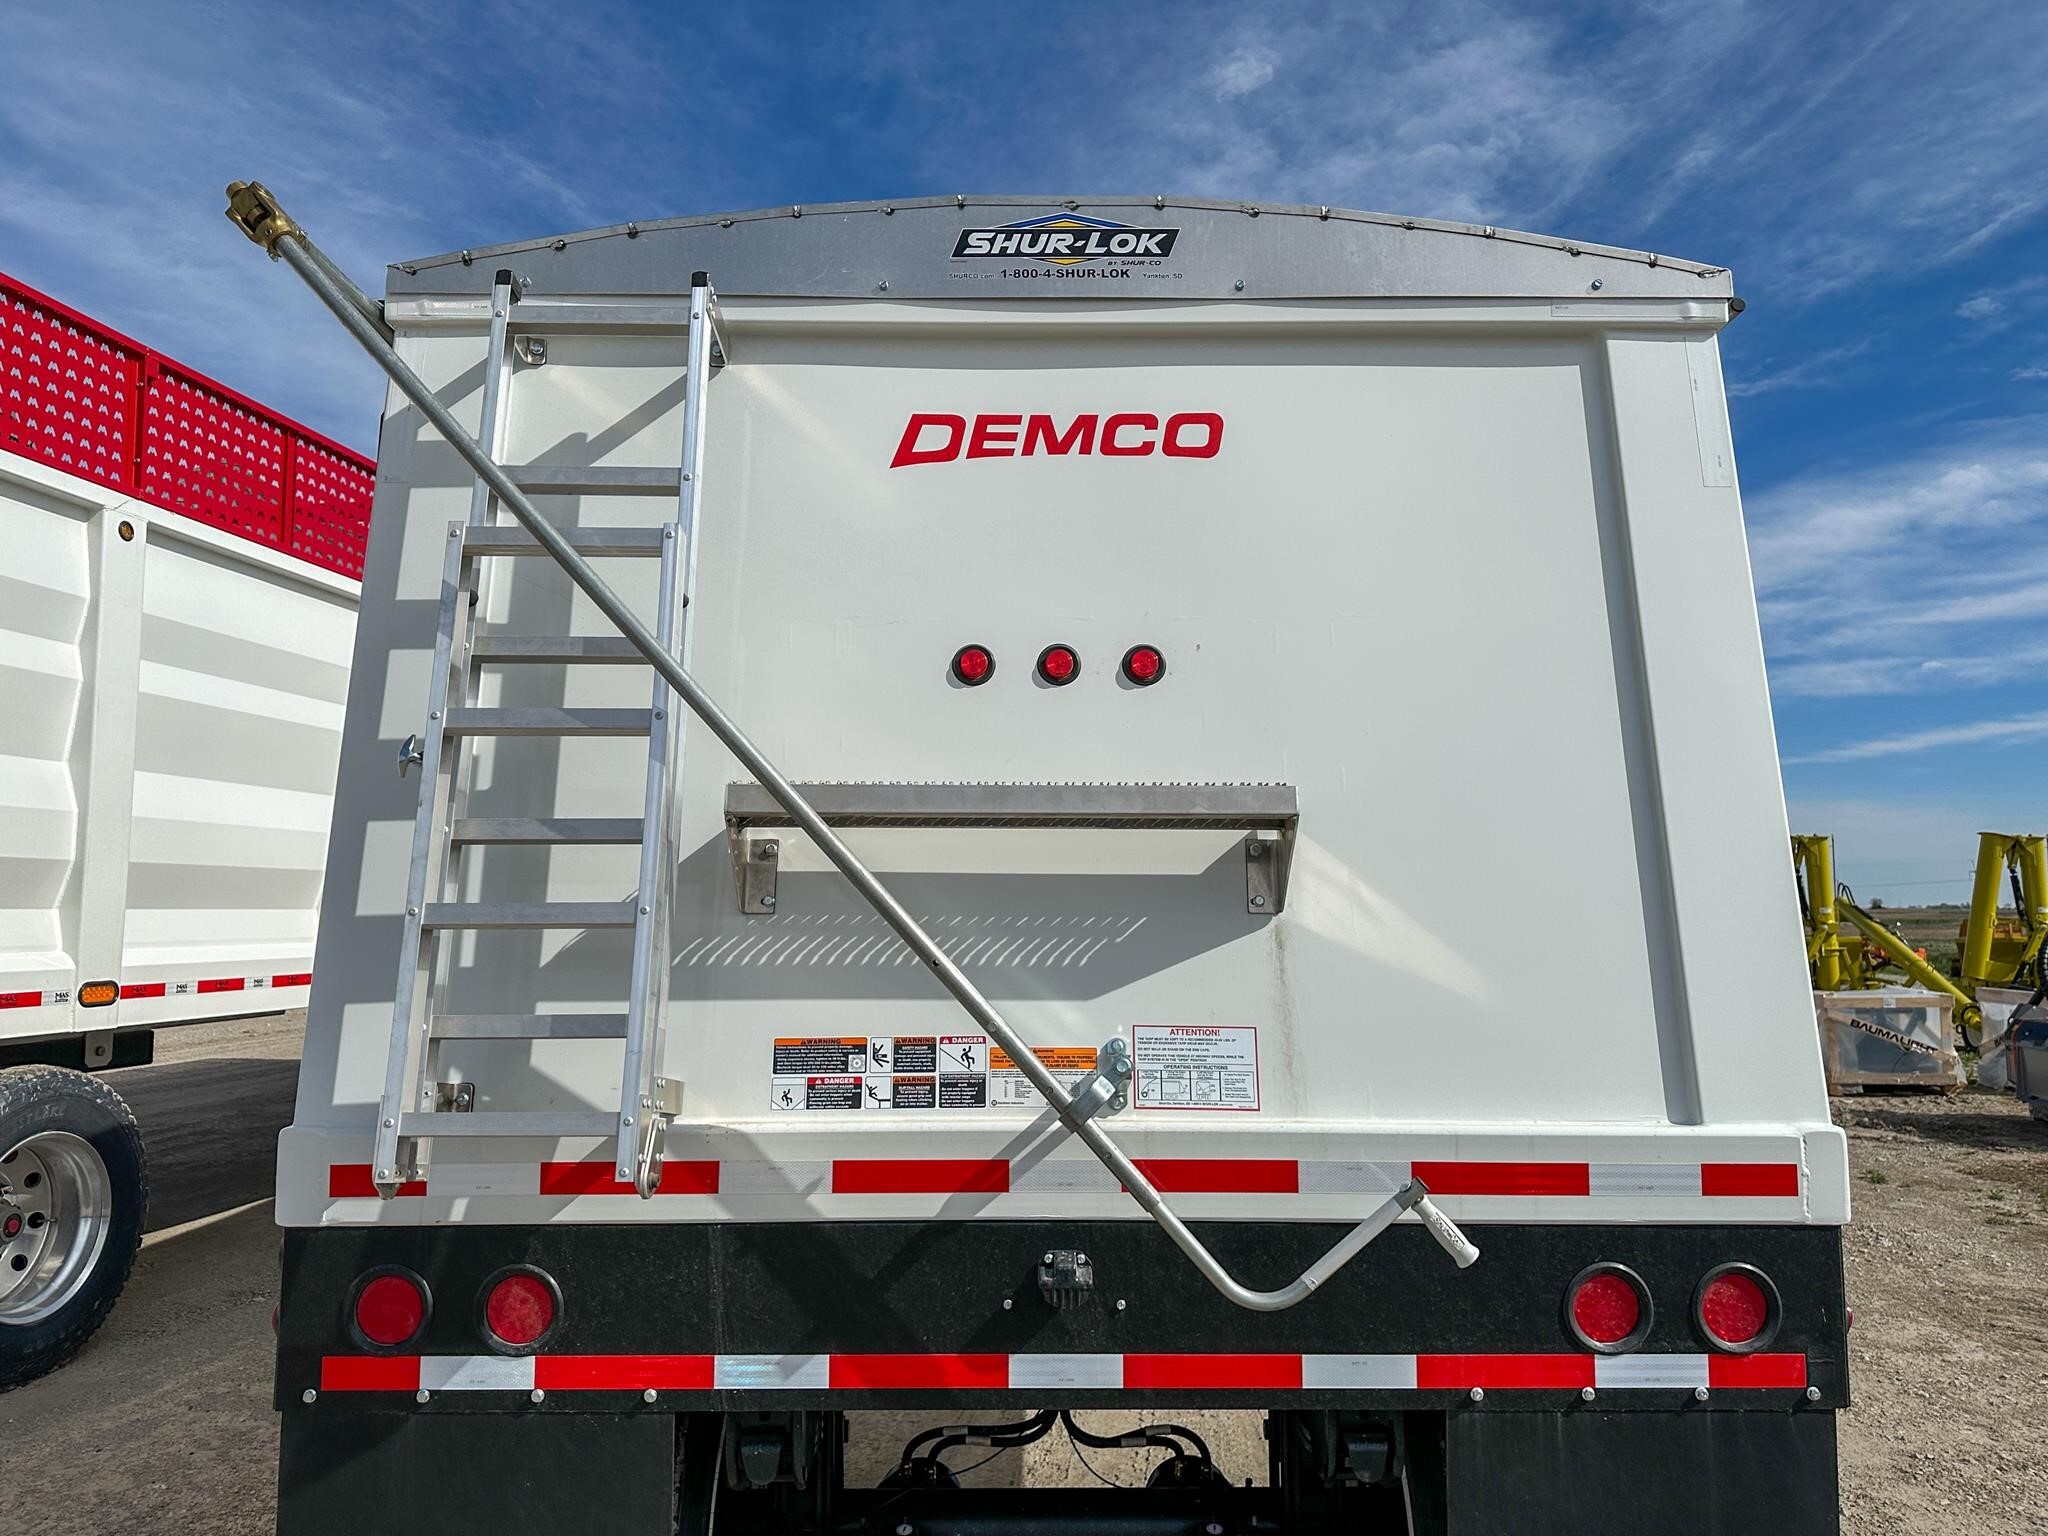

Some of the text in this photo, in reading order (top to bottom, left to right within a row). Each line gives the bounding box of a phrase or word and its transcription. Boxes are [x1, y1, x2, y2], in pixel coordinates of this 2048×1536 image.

[963, 232, 1167, 254] SHUR-LOK
[1000, 268, 1131, 279] 1-800-4-SHUR-LOK
[889, 413, 1224, 469] DEMCO
[1169, 1028, 1220, 1037] ATTENTION!
